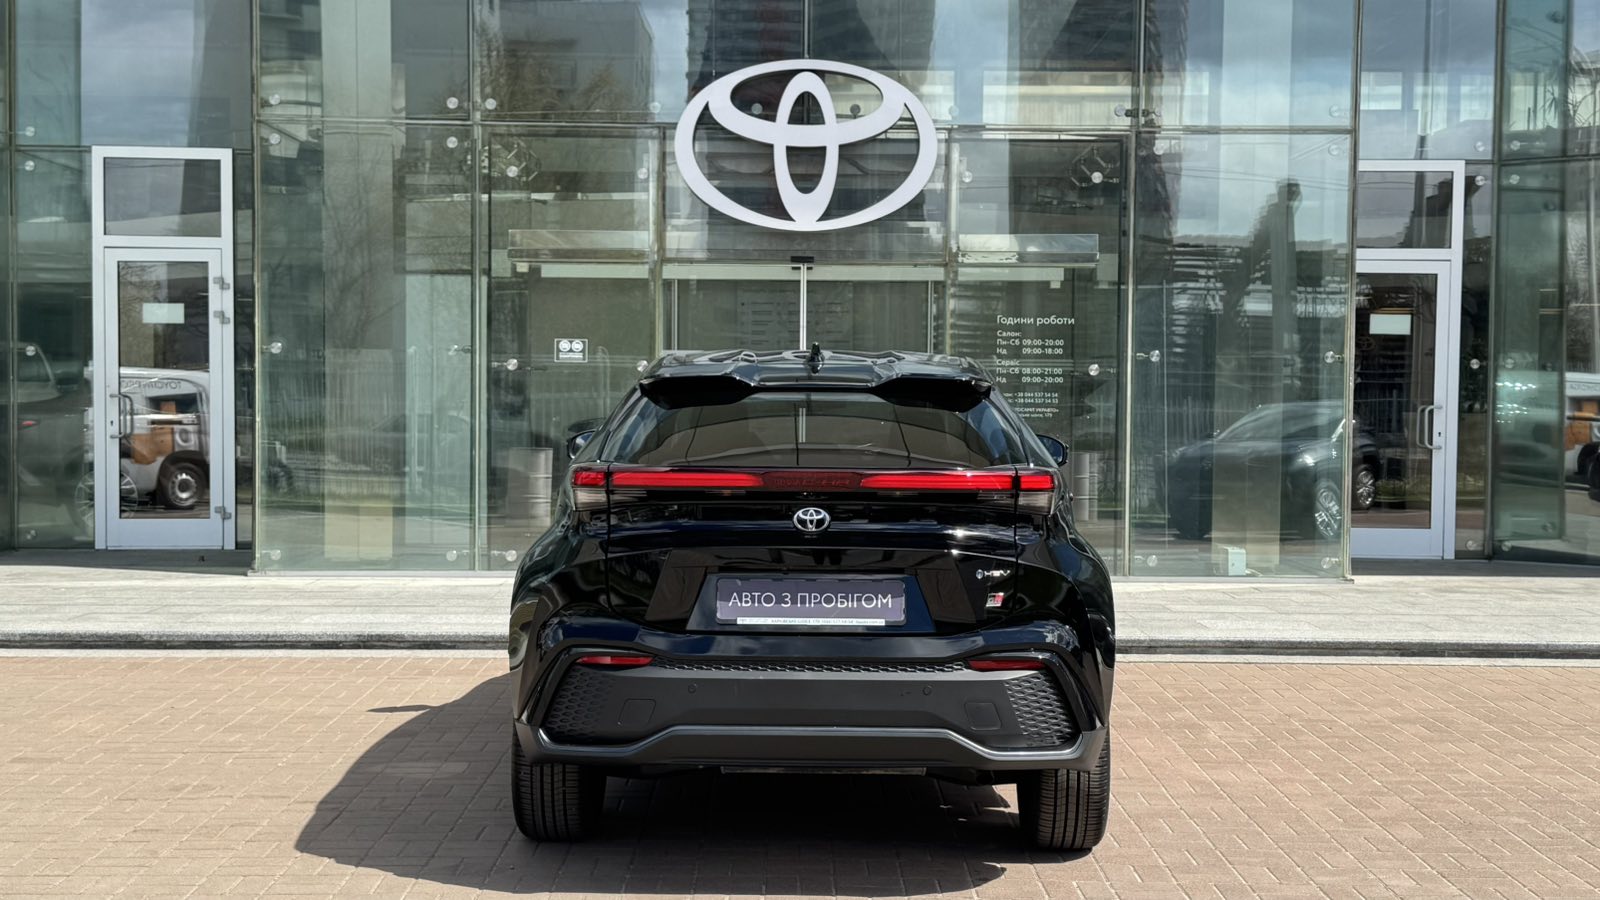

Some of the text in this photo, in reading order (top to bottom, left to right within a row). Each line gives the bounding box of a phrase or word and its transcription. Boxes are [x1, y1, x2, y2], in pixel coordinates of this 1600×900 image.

[997, 315, 1075, 326] Години роботи
[996, 347, 1007, 355] Нд
[1021, 376, 1064, 384] 09:00-20:00
[728, 592, 892, 609] АВТО З ПРОБІГОМ
